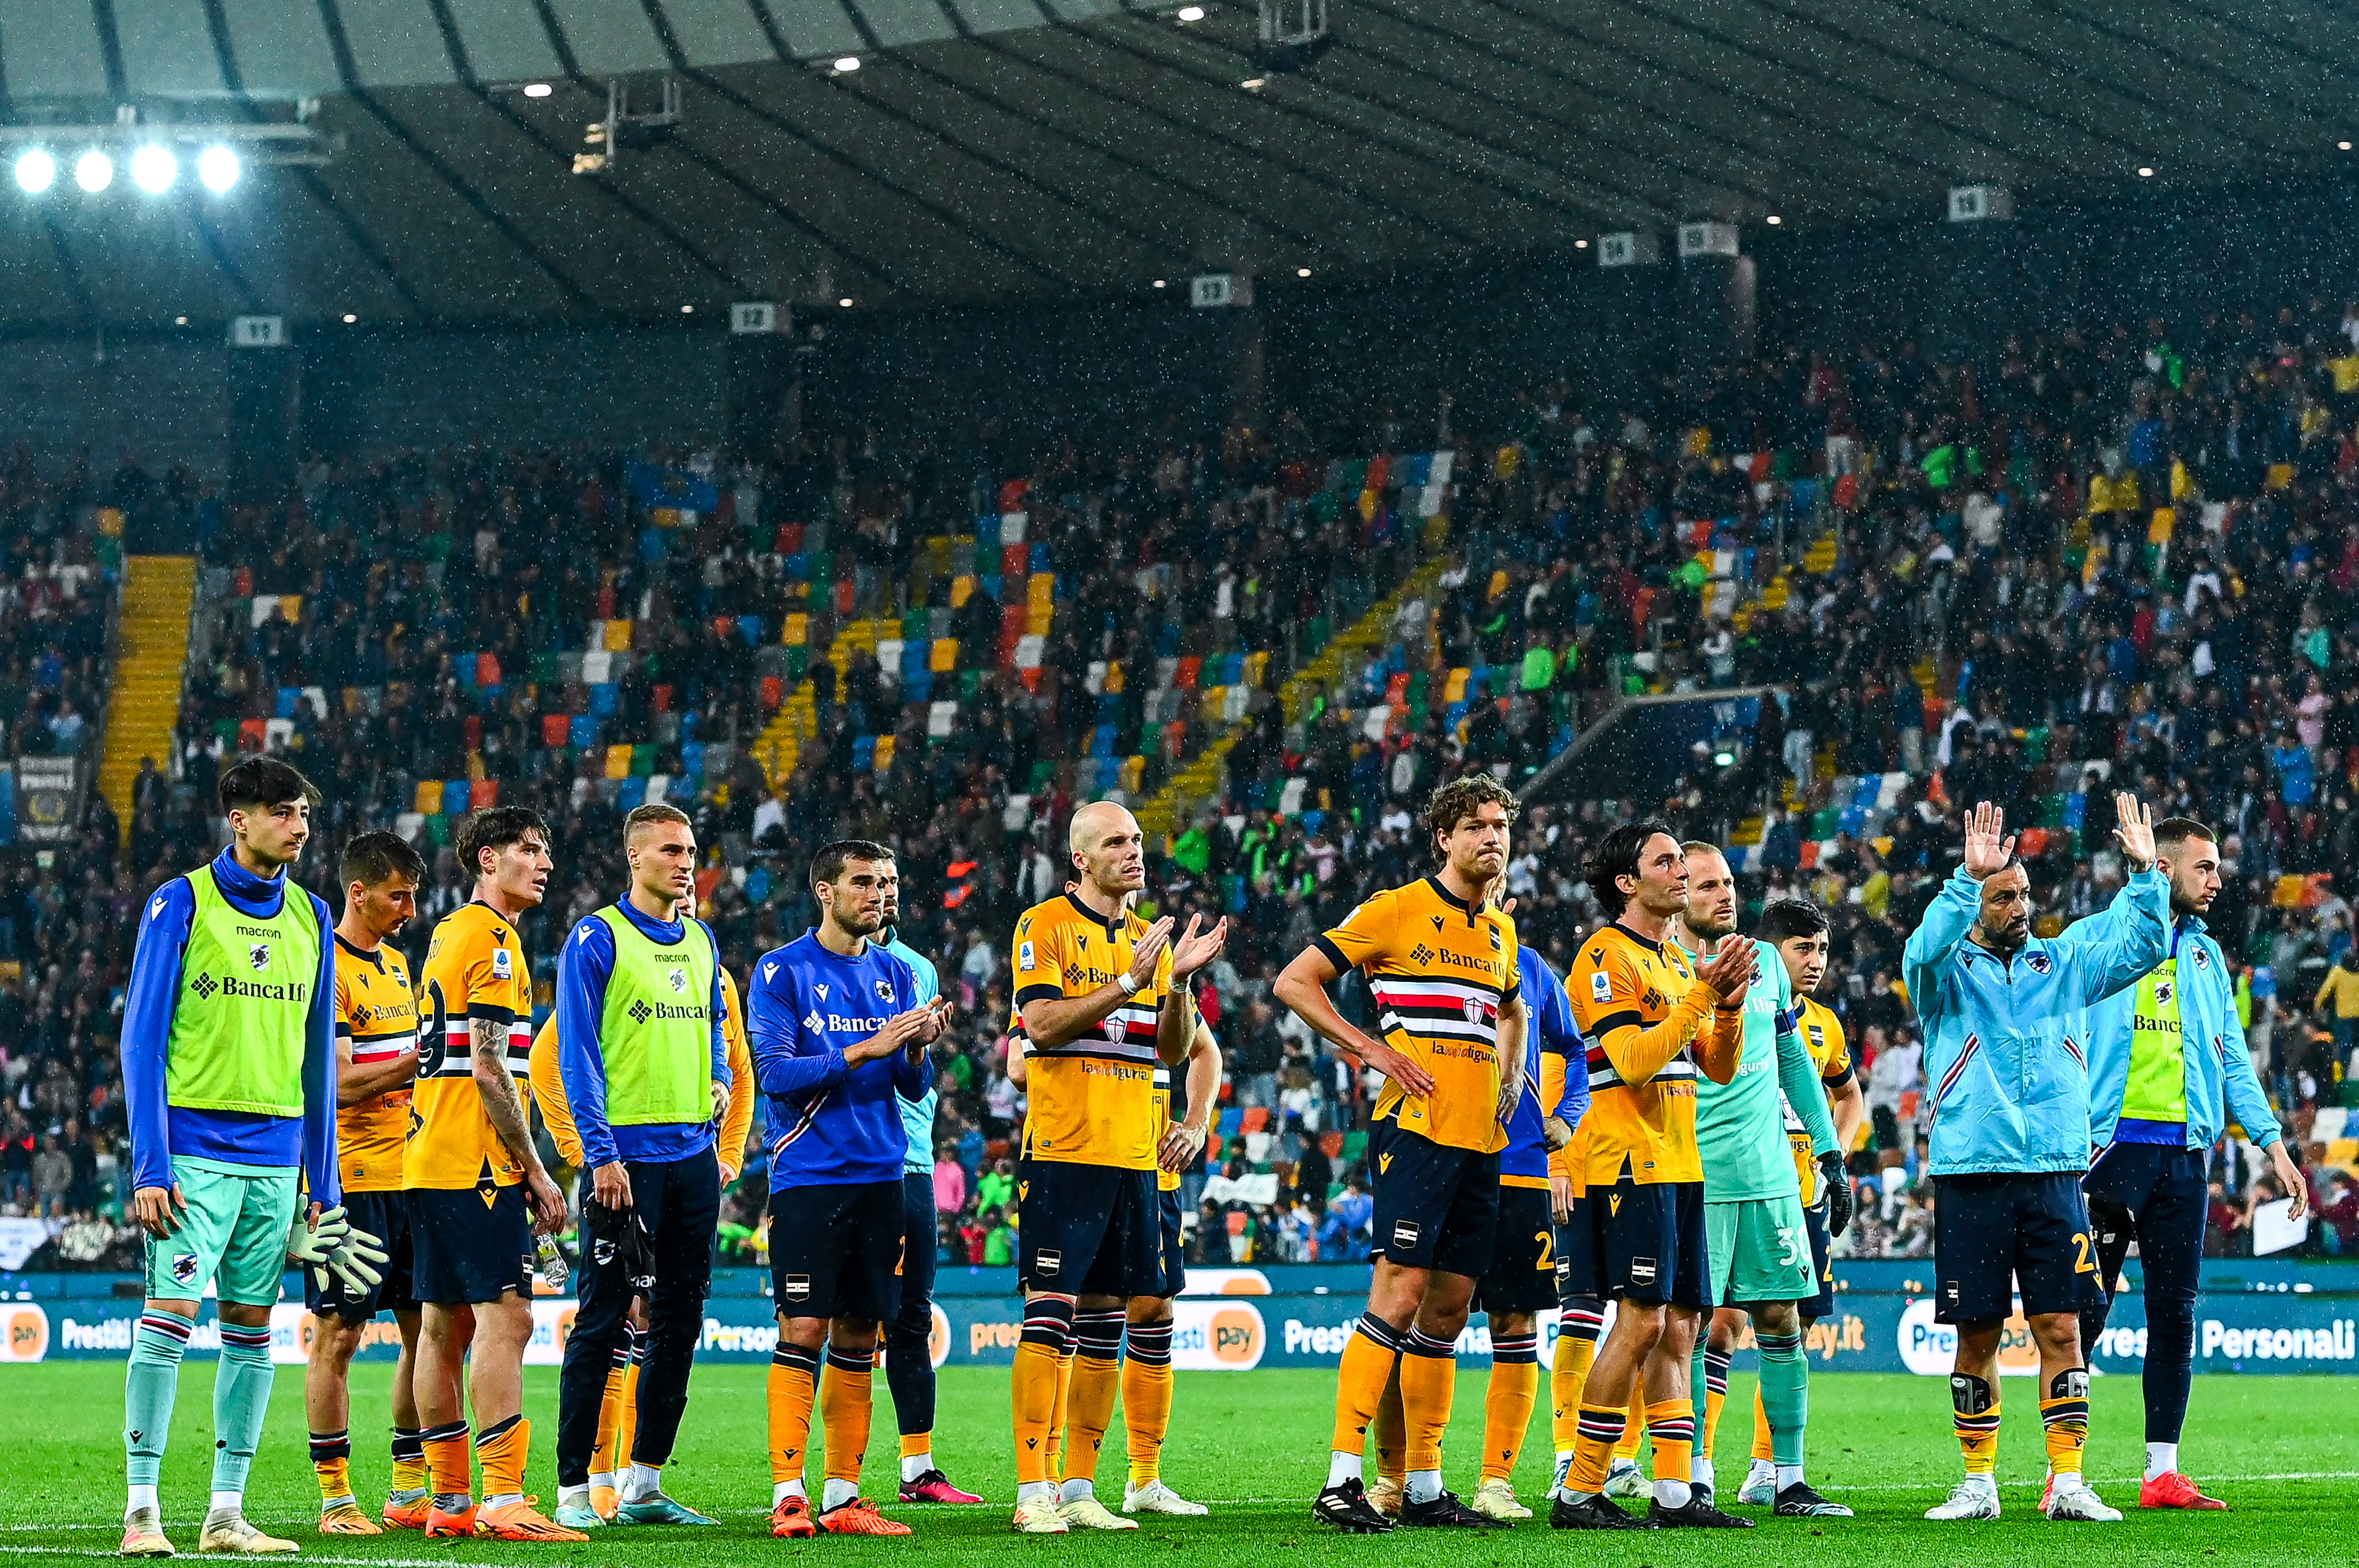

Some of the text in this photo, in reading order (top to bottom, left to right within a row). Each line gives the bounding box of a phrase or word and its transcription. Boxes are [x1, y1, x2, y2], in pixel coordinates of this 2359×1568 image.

[236, 925, 282, 940] macron
[655, 953, 690, 963] macron
[1438, 947, 1492, 973] Banca
[1088, 967, 1118, 984] Ban
[222, 976, 307, 1003] Banca Ifi
[374, 1002, 410, 1021] Banca
[655, 1001, 704, 1019] Banca
[828, 1013, 888, 1033] Banca
[2071, 1232, 2095, 1274] 2
[703, 1318, 778, 1353] Person
[1912, 1324, 1957, 1353] Pre
[2202, 1318, 2356, 1360] Personali
